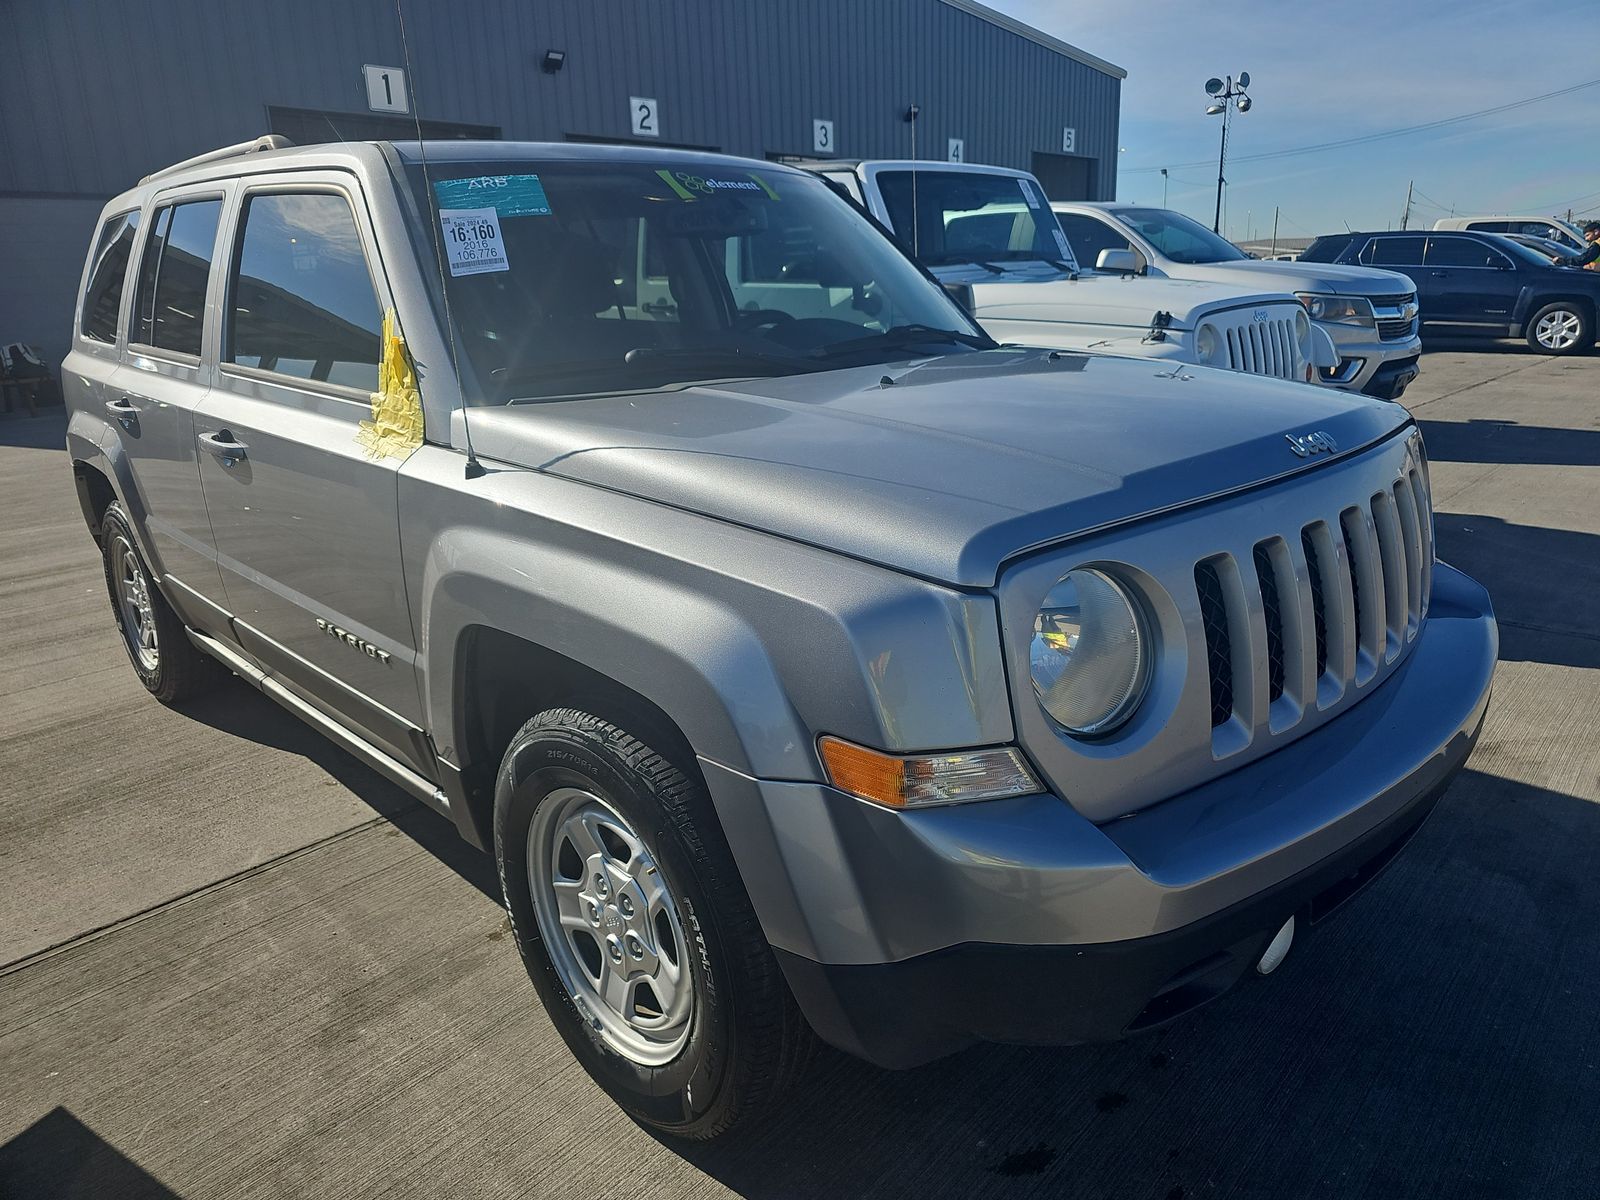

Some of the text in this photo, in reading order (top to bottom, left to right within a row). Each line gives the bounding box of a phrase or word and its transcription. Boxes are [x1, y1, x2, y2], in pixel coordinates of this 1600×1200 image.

[381, 74, 392, 105] 1
[638, 104, 652, 130] 2
[819, 125, 829, 148] 3
[1065, 131, 1072, 149] 5
[952, 143, 960, 163] 4
[705, 178, 760, 191] element
[450, 224, 495, 242] 16:160
[462, 240, 489, 250] 2016
[1285, 431, 1338, 457] Jeep
[316, 618, 391, 665] PATRIOT
